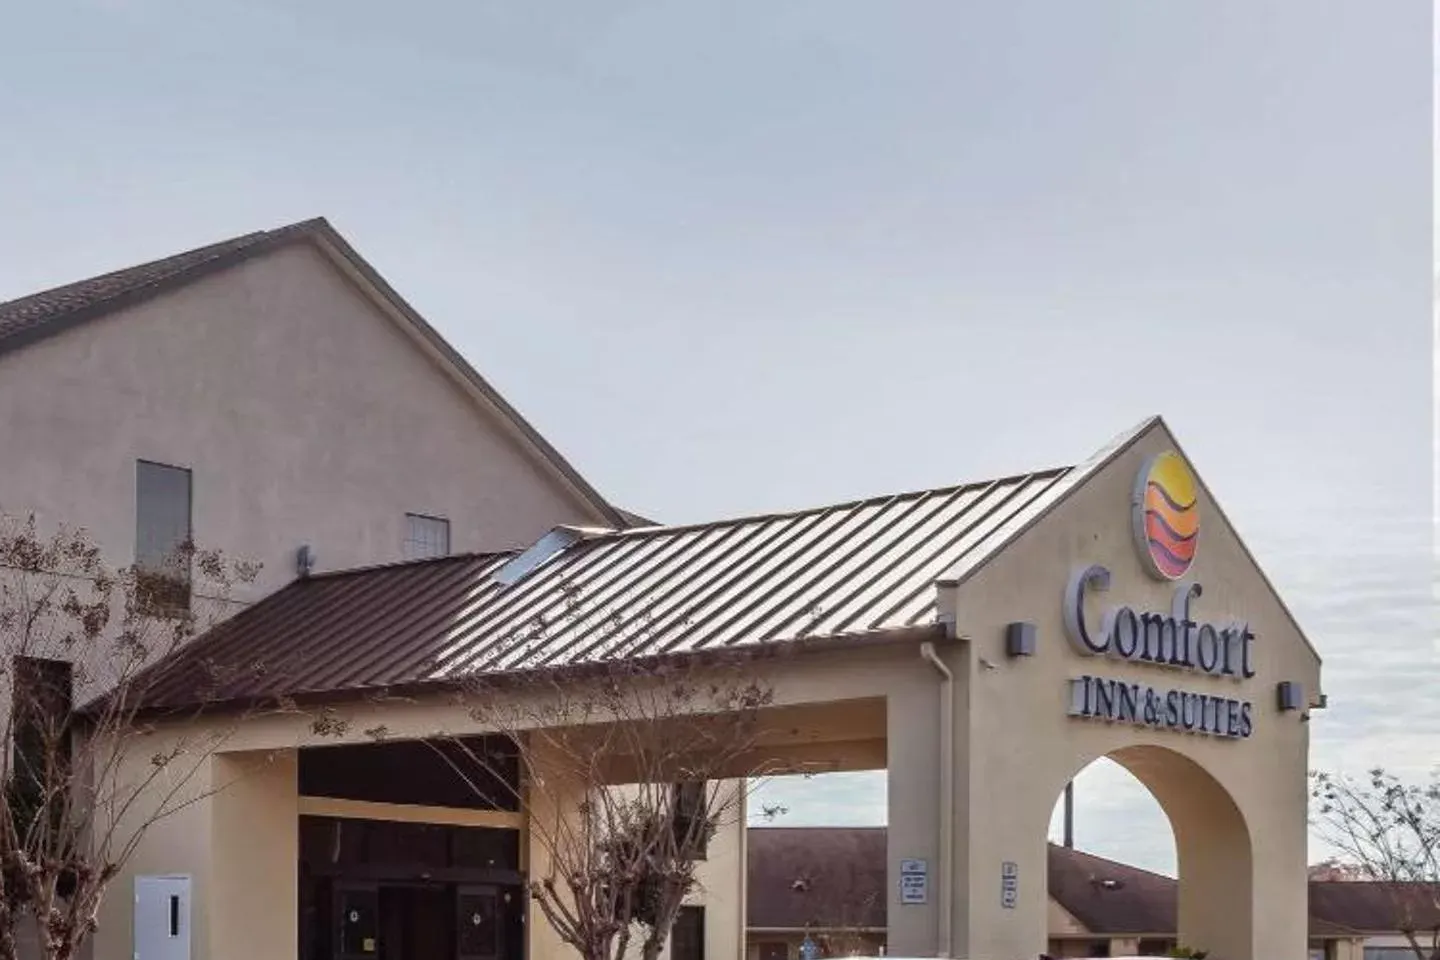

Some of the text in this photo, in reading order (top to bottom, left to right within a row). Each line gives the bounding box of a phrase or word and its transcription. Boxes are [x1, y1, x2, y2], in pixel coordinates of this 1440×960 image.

[1065, 564, 1255, 679] Comfort
[1077, 675, 1140, 722] INN
[1166, 689, 1252, 738] SUITES
